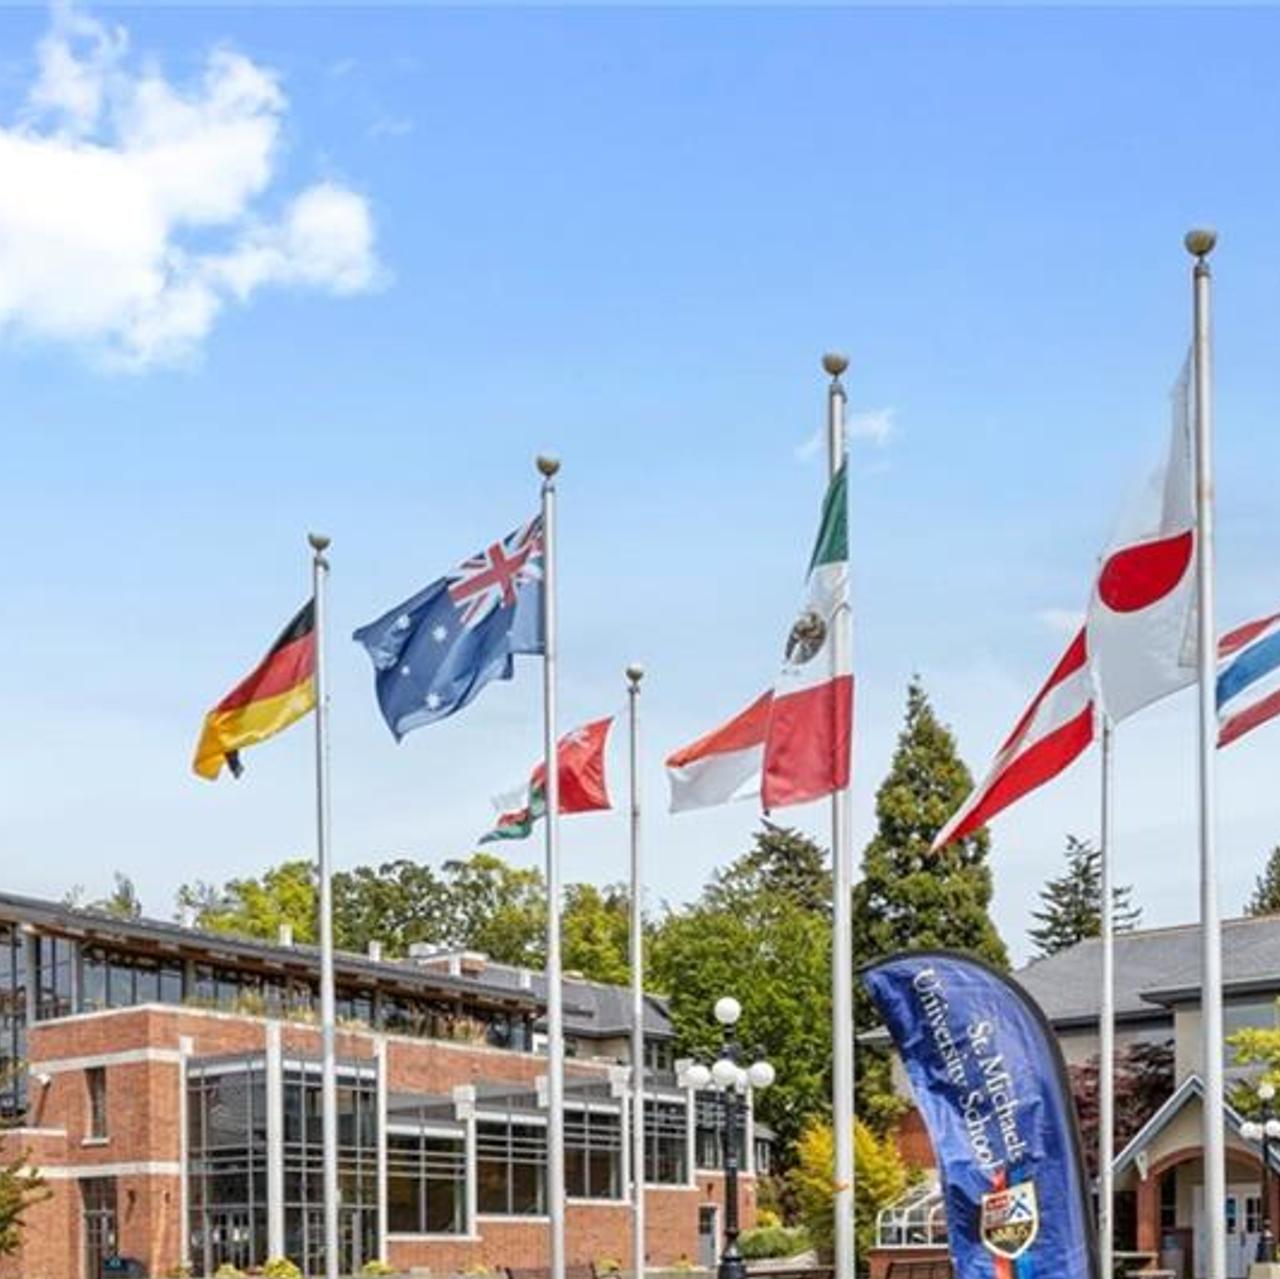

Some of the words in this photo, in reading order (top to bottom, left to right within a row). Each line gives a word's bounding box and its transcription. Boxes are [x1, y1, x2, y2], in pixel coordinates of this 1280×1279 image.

[913, 968, 969, 1087] University
[959, 1090, 1005, 1170] School
[967, 1020, 994, 1055] St.
